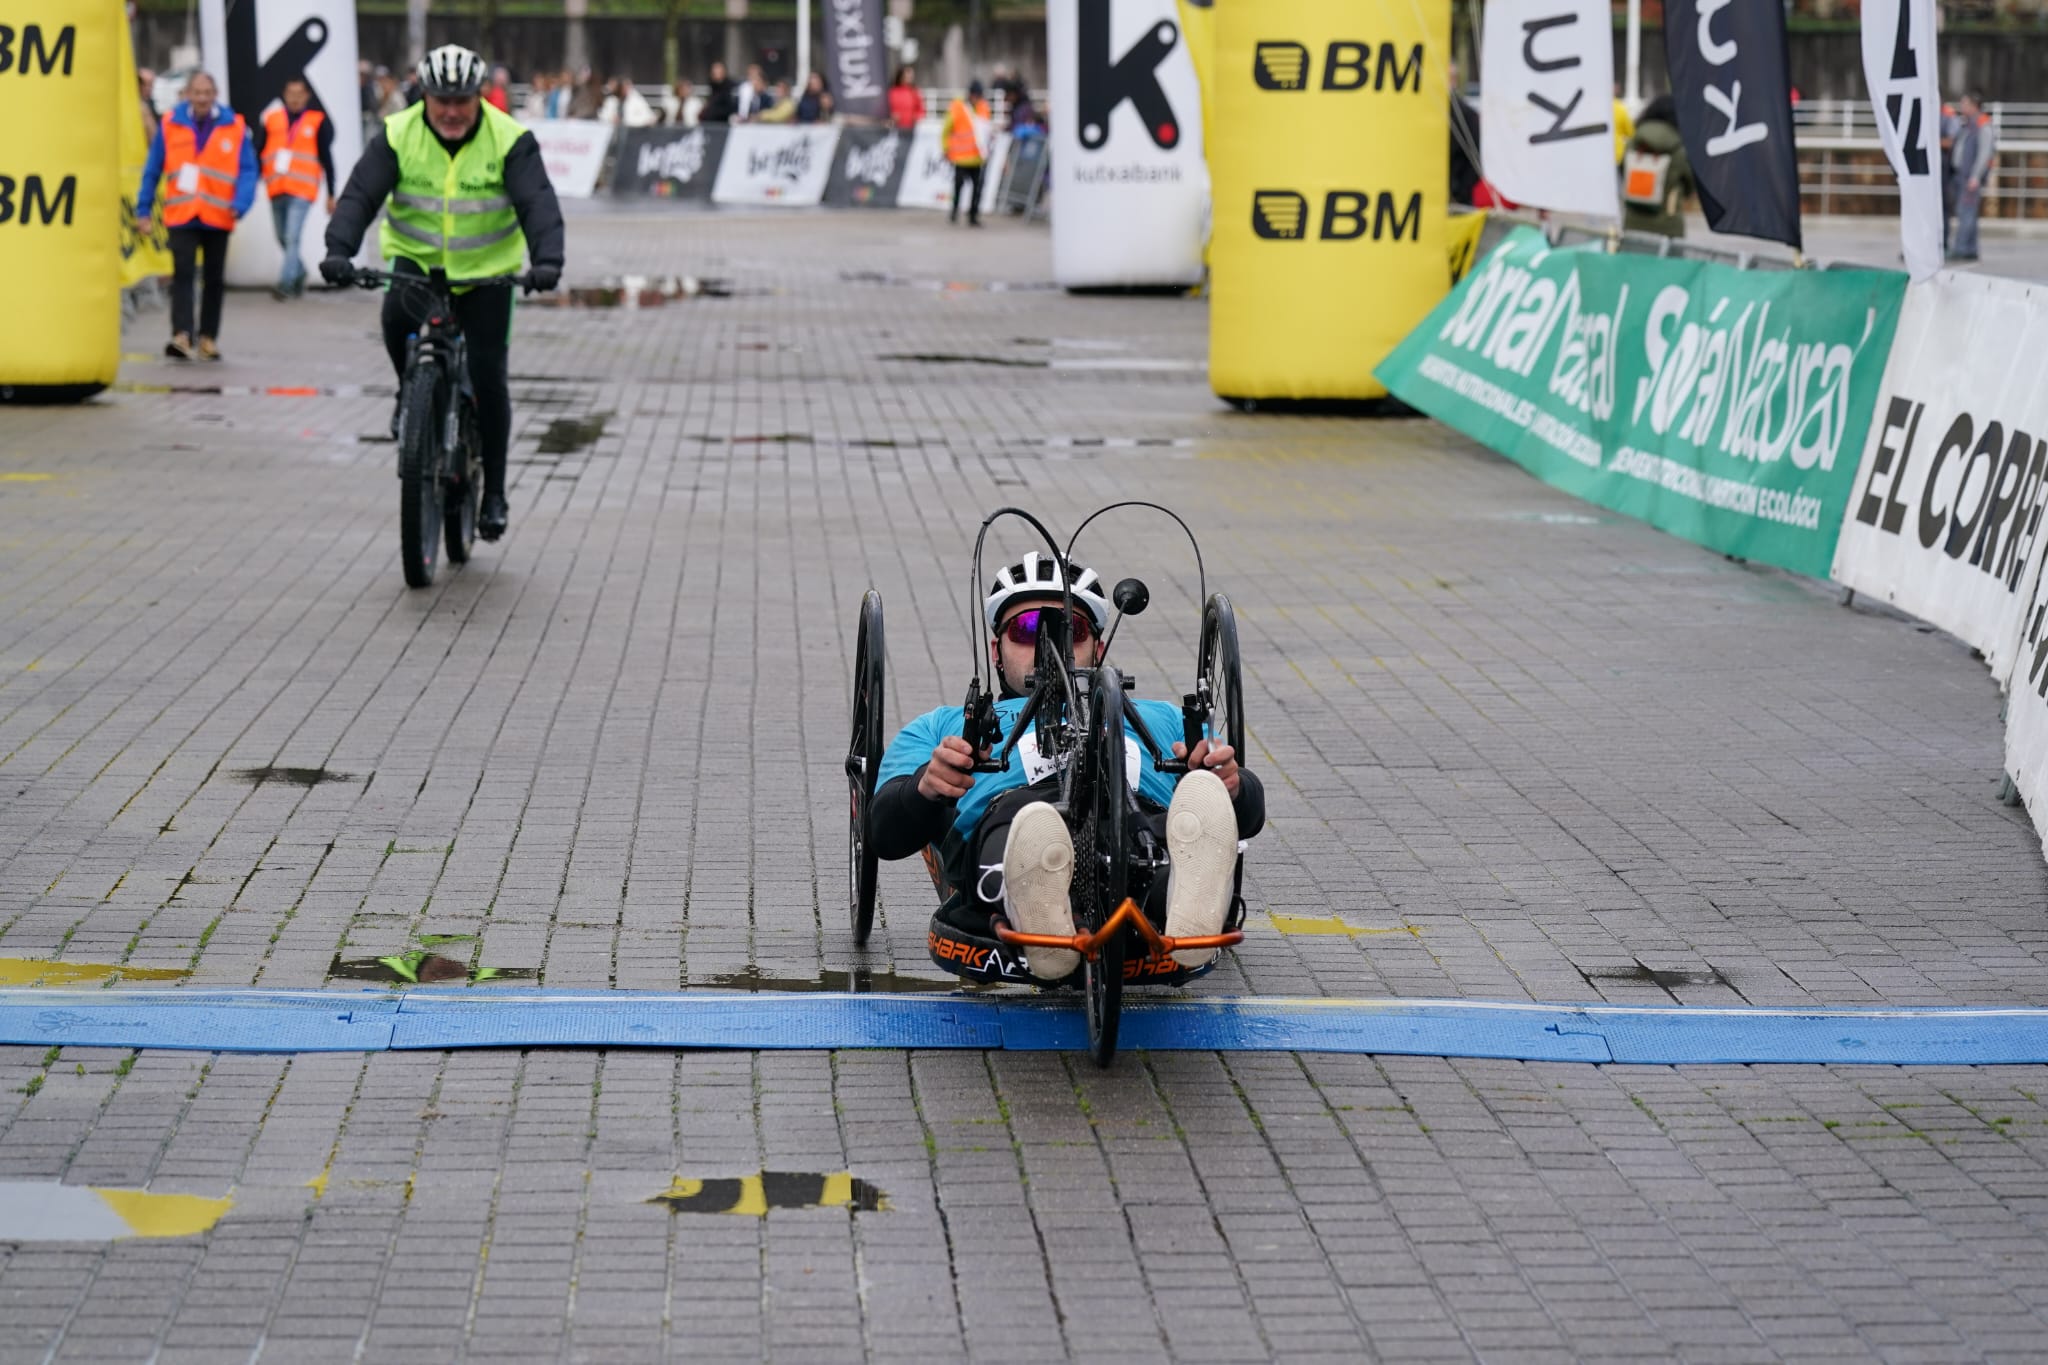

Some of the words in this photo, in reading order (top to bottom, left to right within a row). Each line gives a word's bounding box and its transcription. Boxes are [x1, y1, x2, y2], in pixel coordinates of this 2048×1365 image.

[1321, 41, 1424, 92] BM
[1075, 164, 1182, 182] kutxabank
[1320, 190, 1422, 241] BM
[1856, 395, 1926, 536] EL
[928, 930, 990, 967] SHARK
